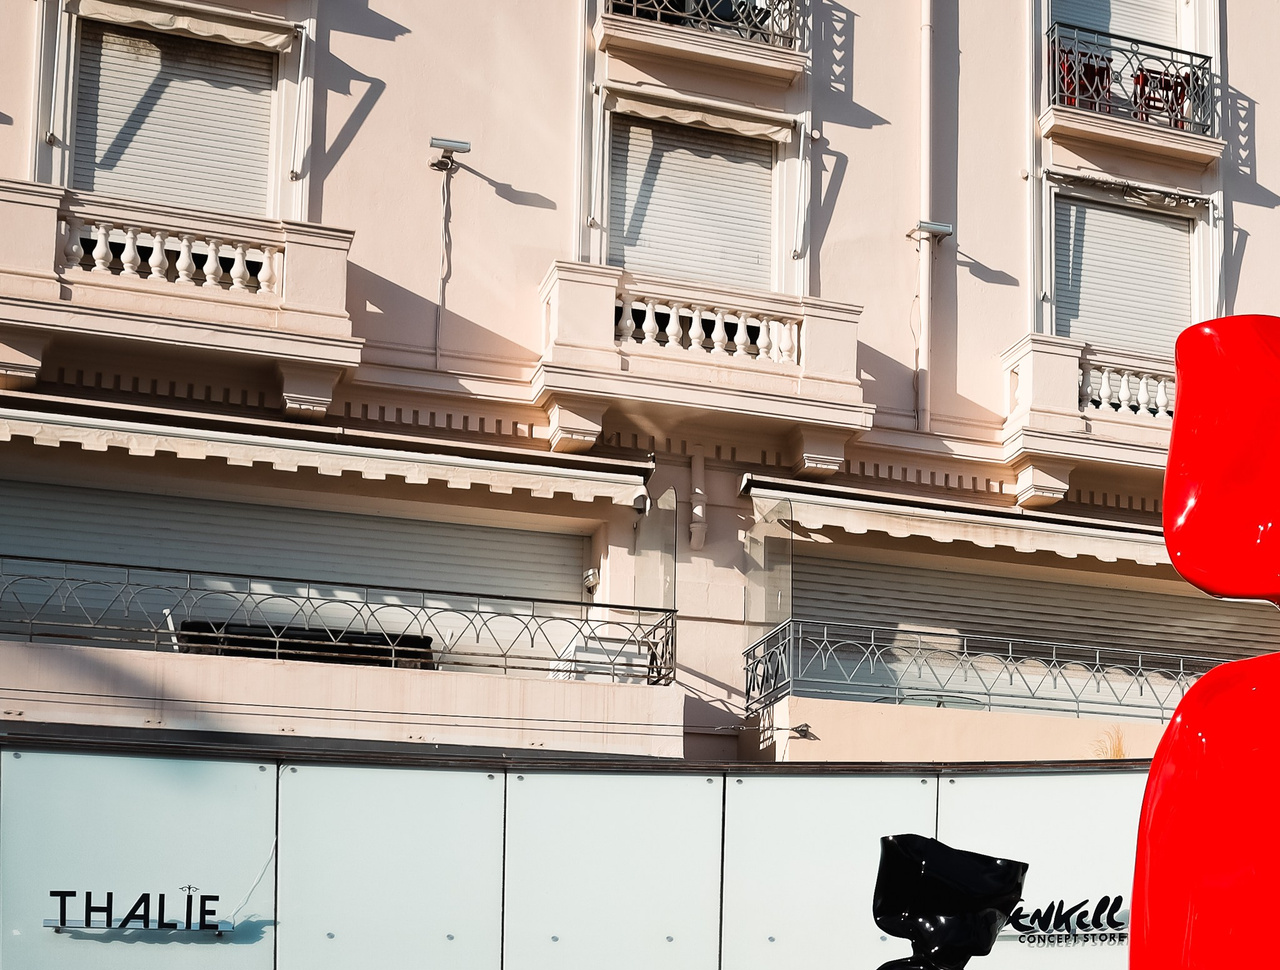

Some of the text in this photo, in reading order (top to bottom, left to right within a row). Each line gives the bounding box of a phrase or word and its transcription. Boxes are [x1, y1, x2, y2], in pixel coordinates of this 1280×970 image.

[49, 890, 220, 930] THALIE
[1018, 933, 1128, 944] CONCEPT STORE
